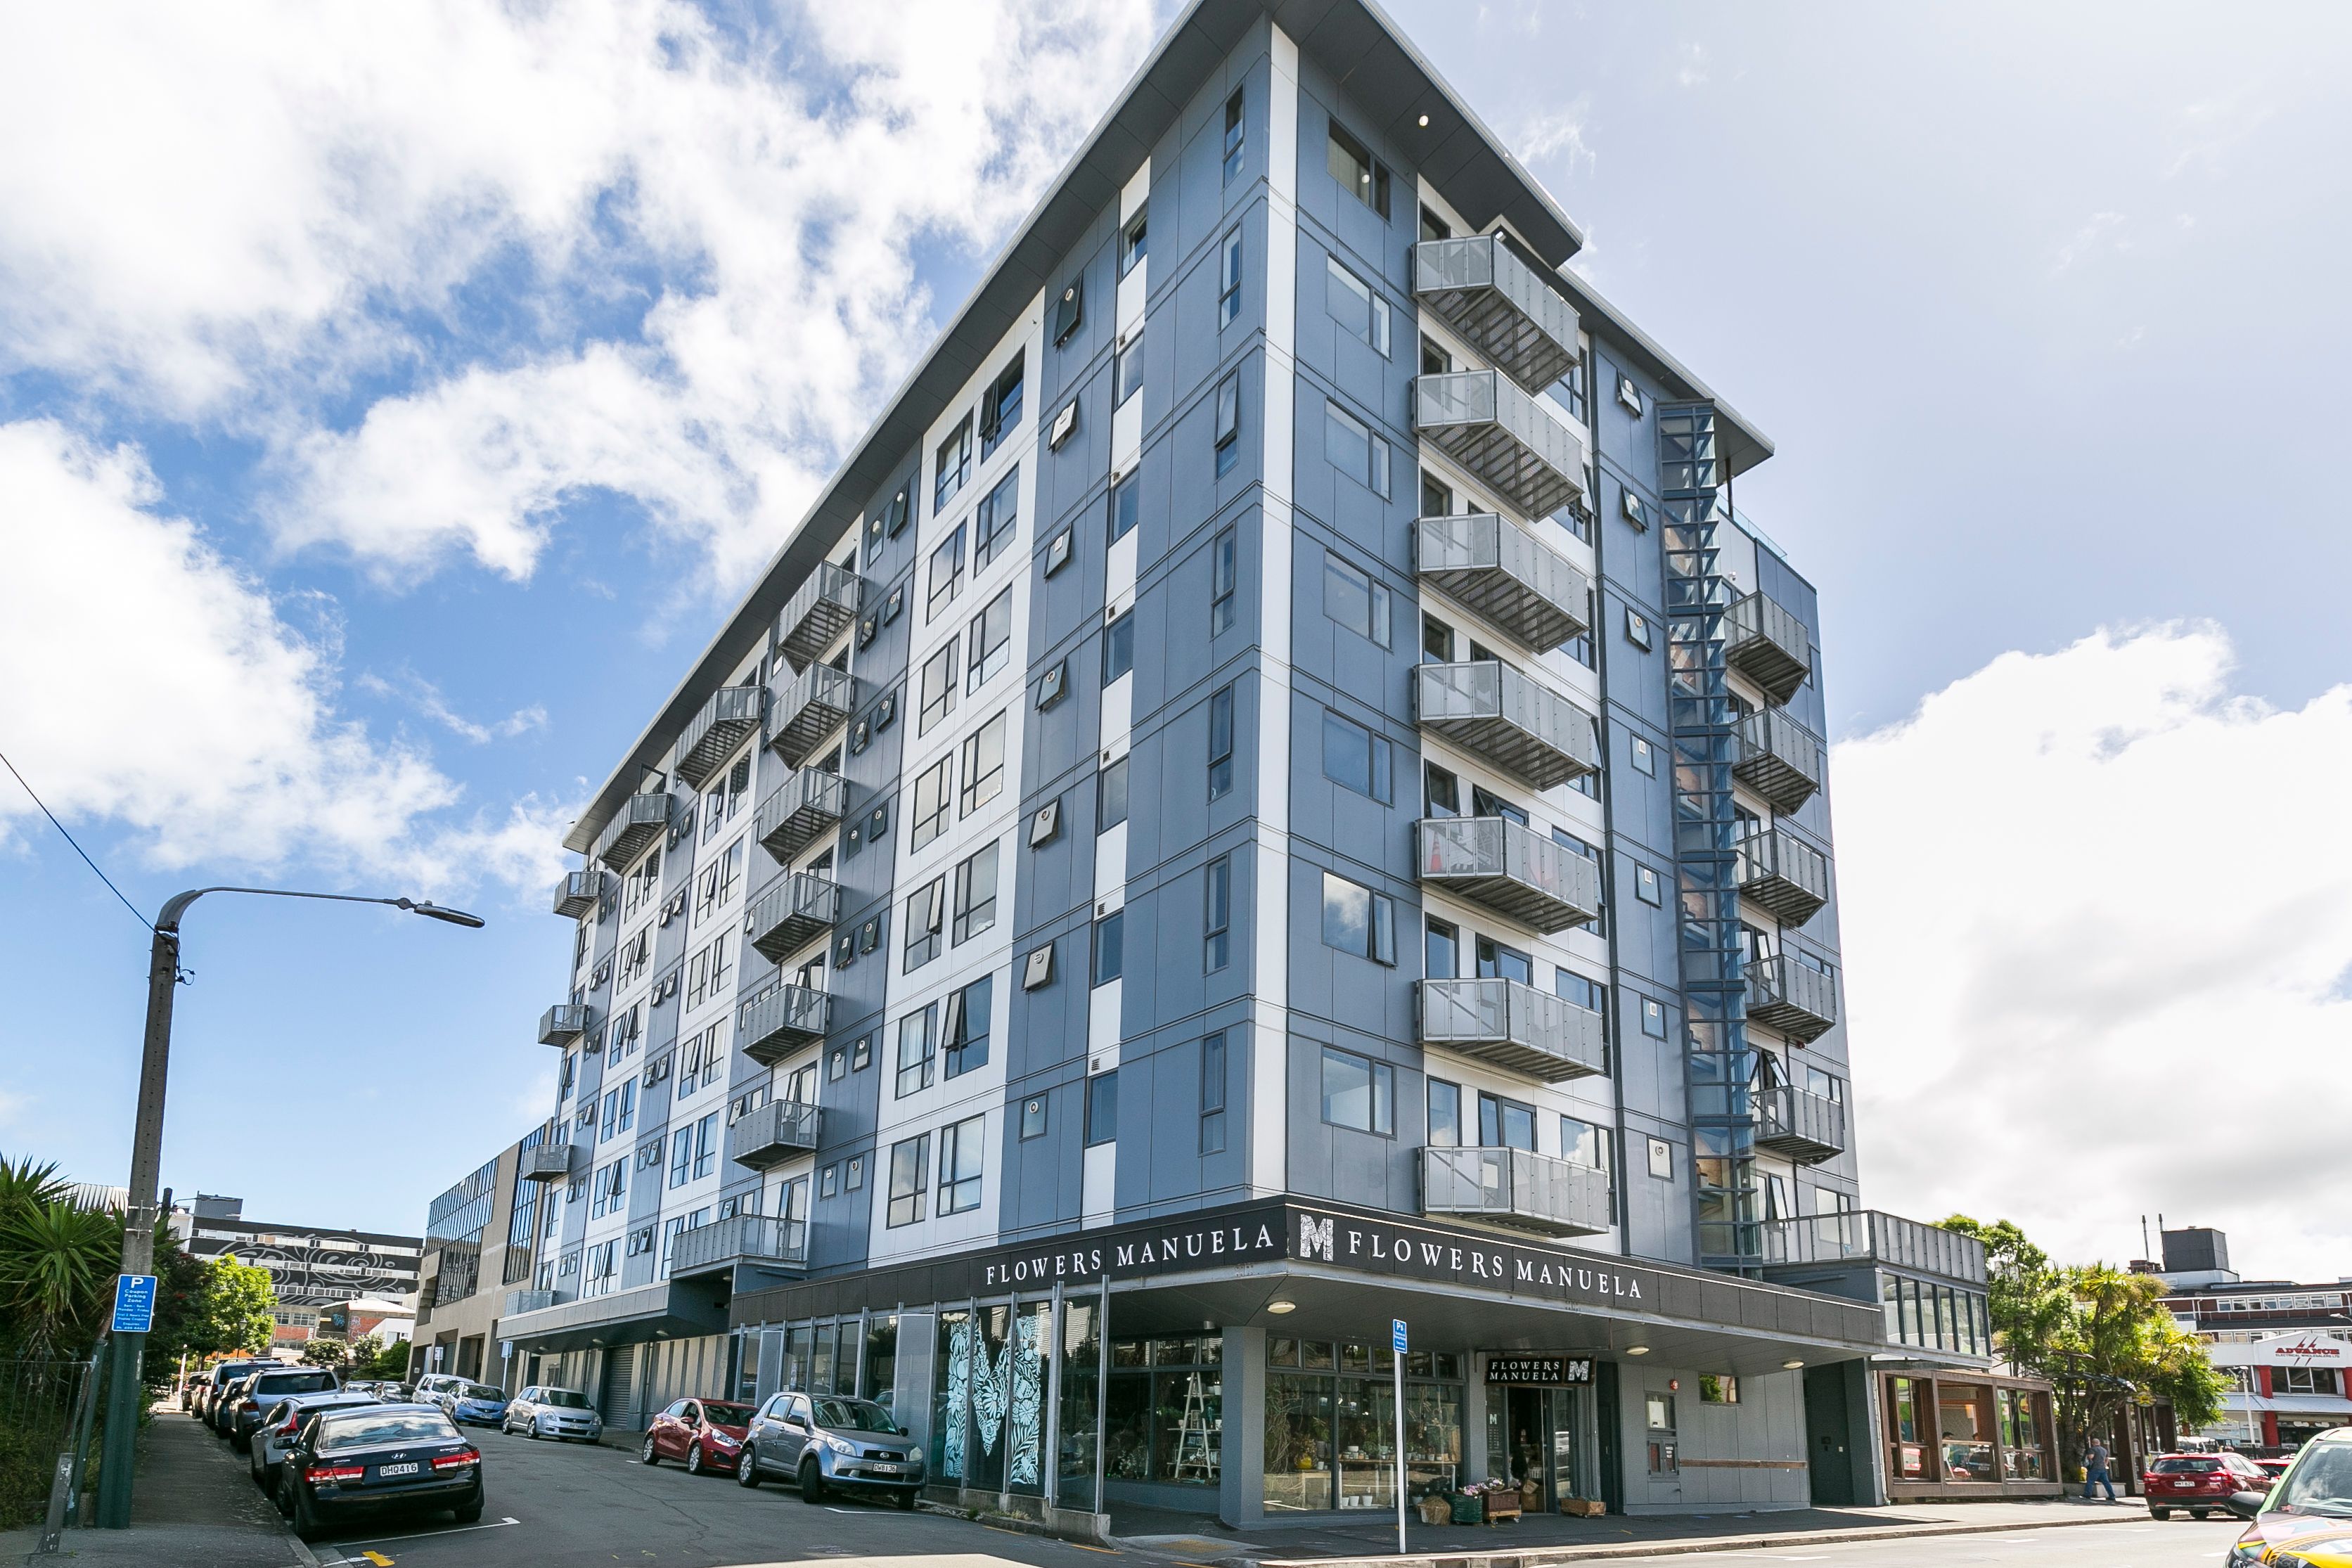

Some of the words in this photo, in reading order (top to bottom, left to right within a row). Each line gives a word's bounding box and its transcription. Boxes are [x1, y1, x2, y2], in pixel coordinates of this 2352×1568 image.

[986, 1249, 1101, 1285] FLOWERS
[1117, 1223, 1274, 1267] MANUELA
[1347, 1230, 1503, 1278] FLOWERS
[1516, 1258, 1643, 1299] MANUELA
[131, 1277, 144, 1288] P
[1491, 1361, 1560, 1370] FLOWERS
[1489, 1372, 1559, 1380] MANUELA
[381, 1465, 418, 1475] DHQ416
[874, 1464, 896, 1472] DWB136
